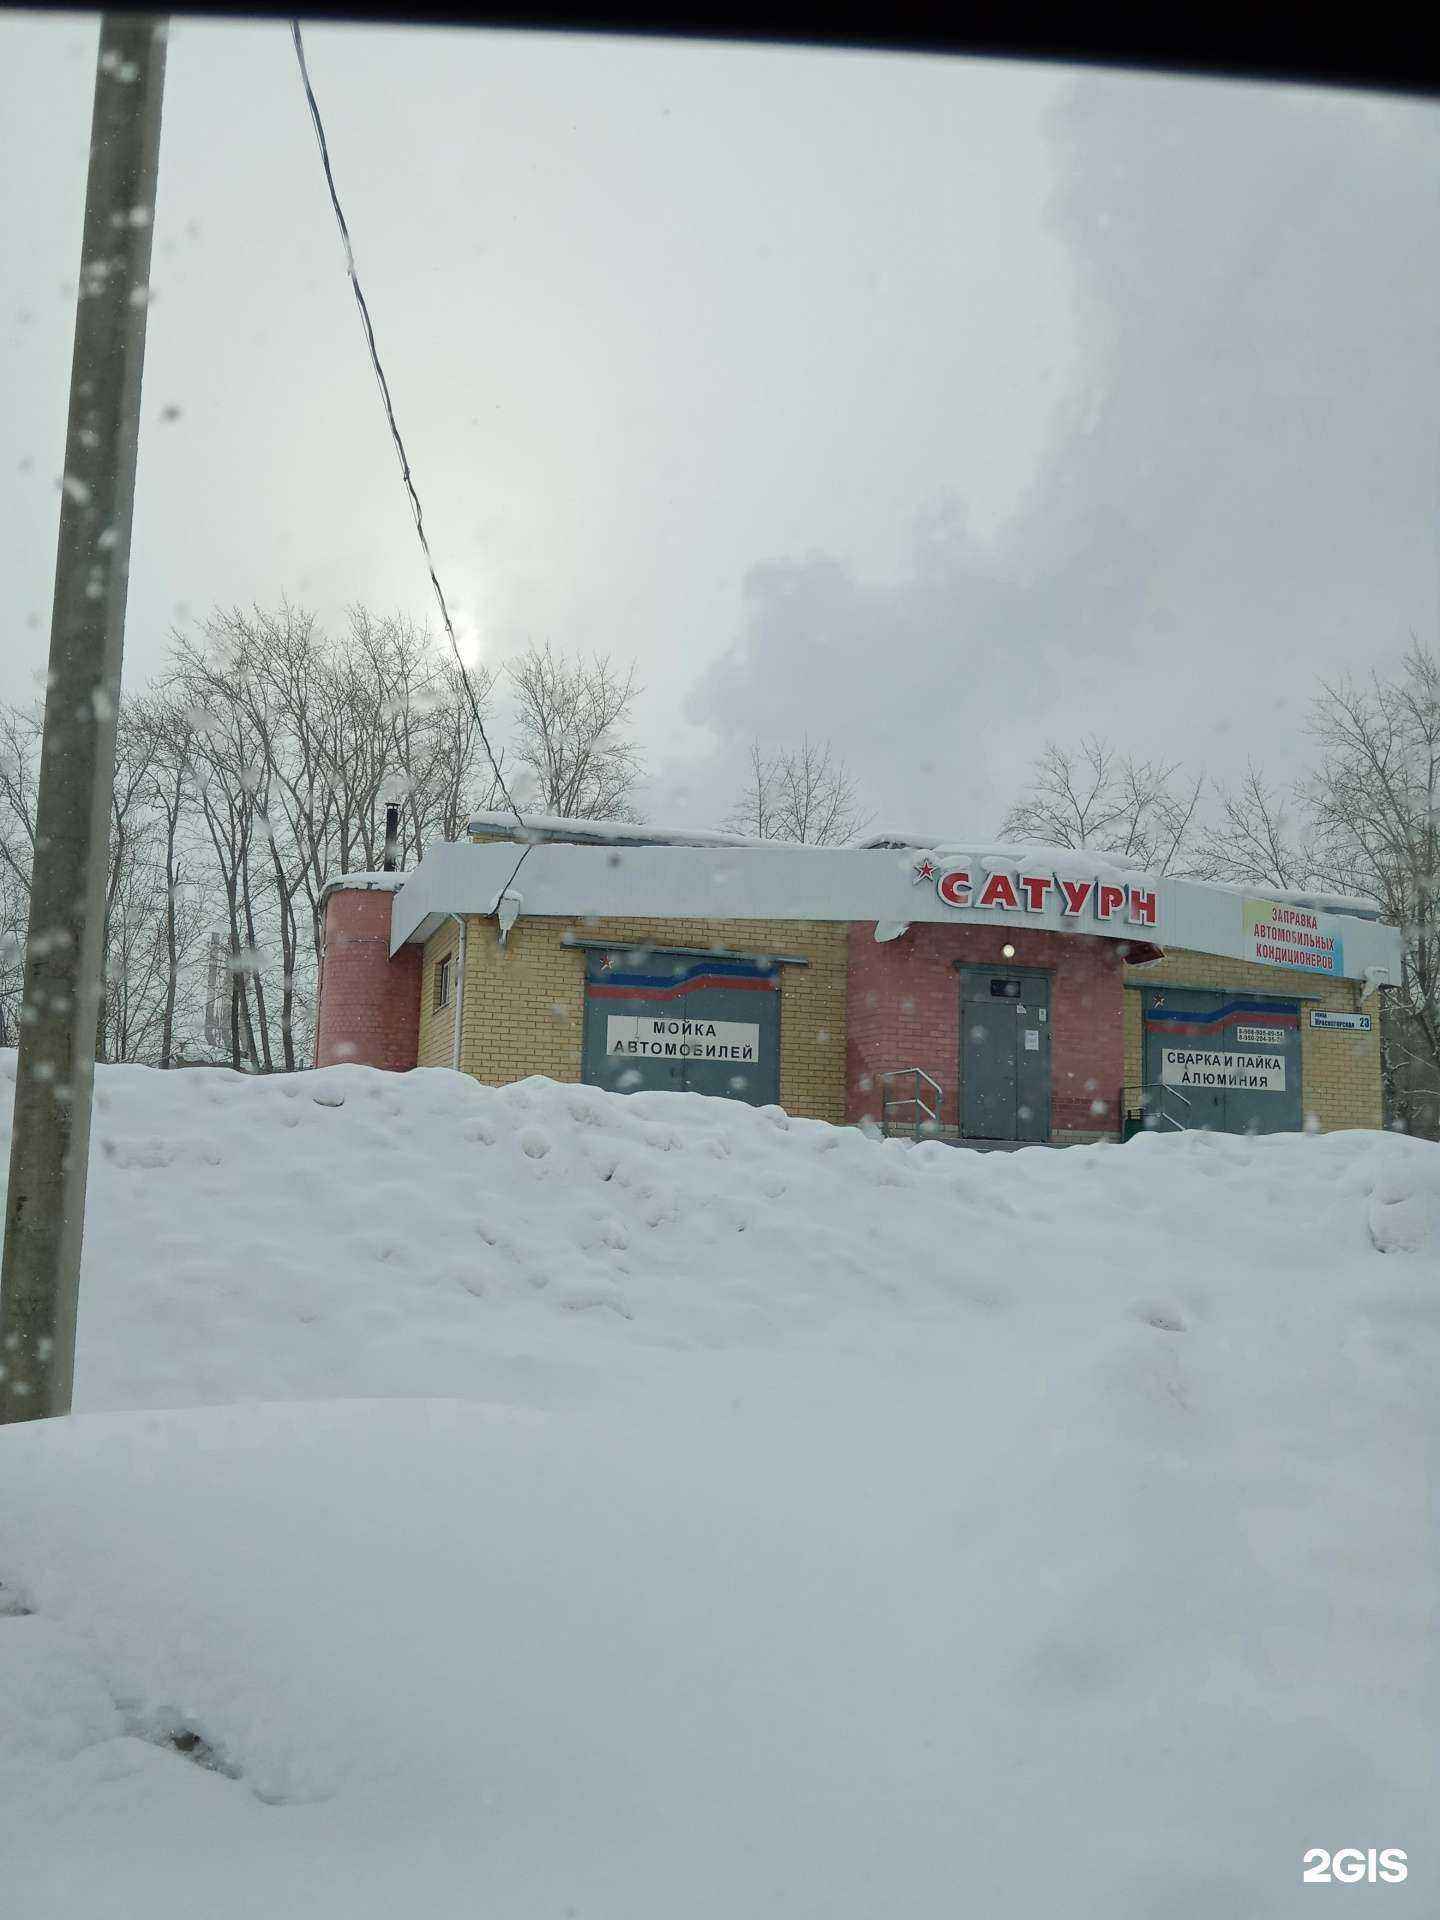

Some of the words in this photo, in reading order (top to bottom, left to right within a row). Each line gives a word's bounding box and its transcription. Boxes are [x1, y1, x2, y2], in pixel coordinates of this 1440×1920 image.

[938, 870, 1158, 928] САТУРН
[1272, 907, 1318, 930] ЗАПРАВКА
[1254, 923, 1335, 951] АВТОМОБИЛЬНЫХ
[1256, 943, 1333, 969] КОНДИЦИОНЕРОВ
[653, 1019, 717, 1037] МОЙКА
[1359, 1016, 1370, 1028] 23
[613, 1040, 753, 1059] АВТОМОБИЛЕЙ
[1167, 1052, 1221, 1067] СВАРКА
[1224, 1056, 1233, 1067] И
[1237, 1055, 1281, 1070] ПАЙКА
[1182, 1071, 1268, 1088] АЛЮМИНИЯ
